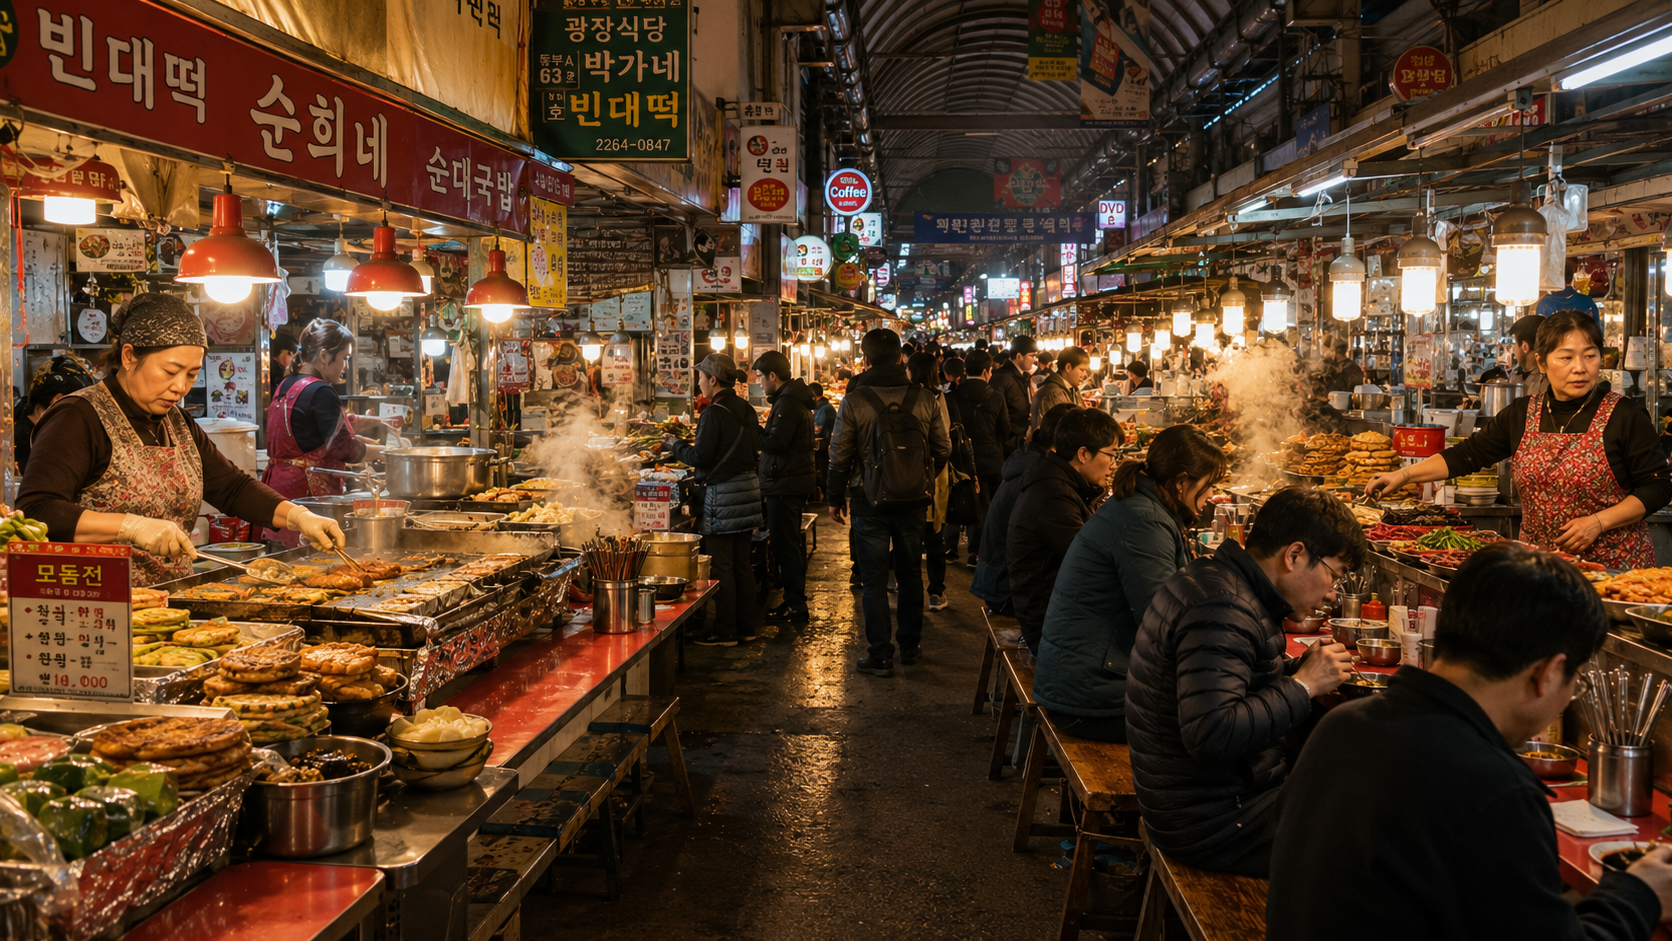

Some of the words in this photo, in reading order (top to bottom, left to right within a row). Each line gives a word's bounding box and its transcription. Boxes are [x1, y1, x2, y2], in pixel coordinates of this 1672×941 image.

[565, 16, 667, 43] 광장식당
[584, 50, 680, 83] 박가네
[37, 8, 206, 125] 빈대떡
[250, 74, 388, 189] 순희네
[570, 91, 679, 128] 빈대떡
[595, 138, 671, 151] 2264-0847
[426, 145, 514, 213] 순대국밥
[830, 186, 867, 198] Coffee
[1099, 203, 1124, 214] DVD
[35, 564, 102, 587] 모돔전
